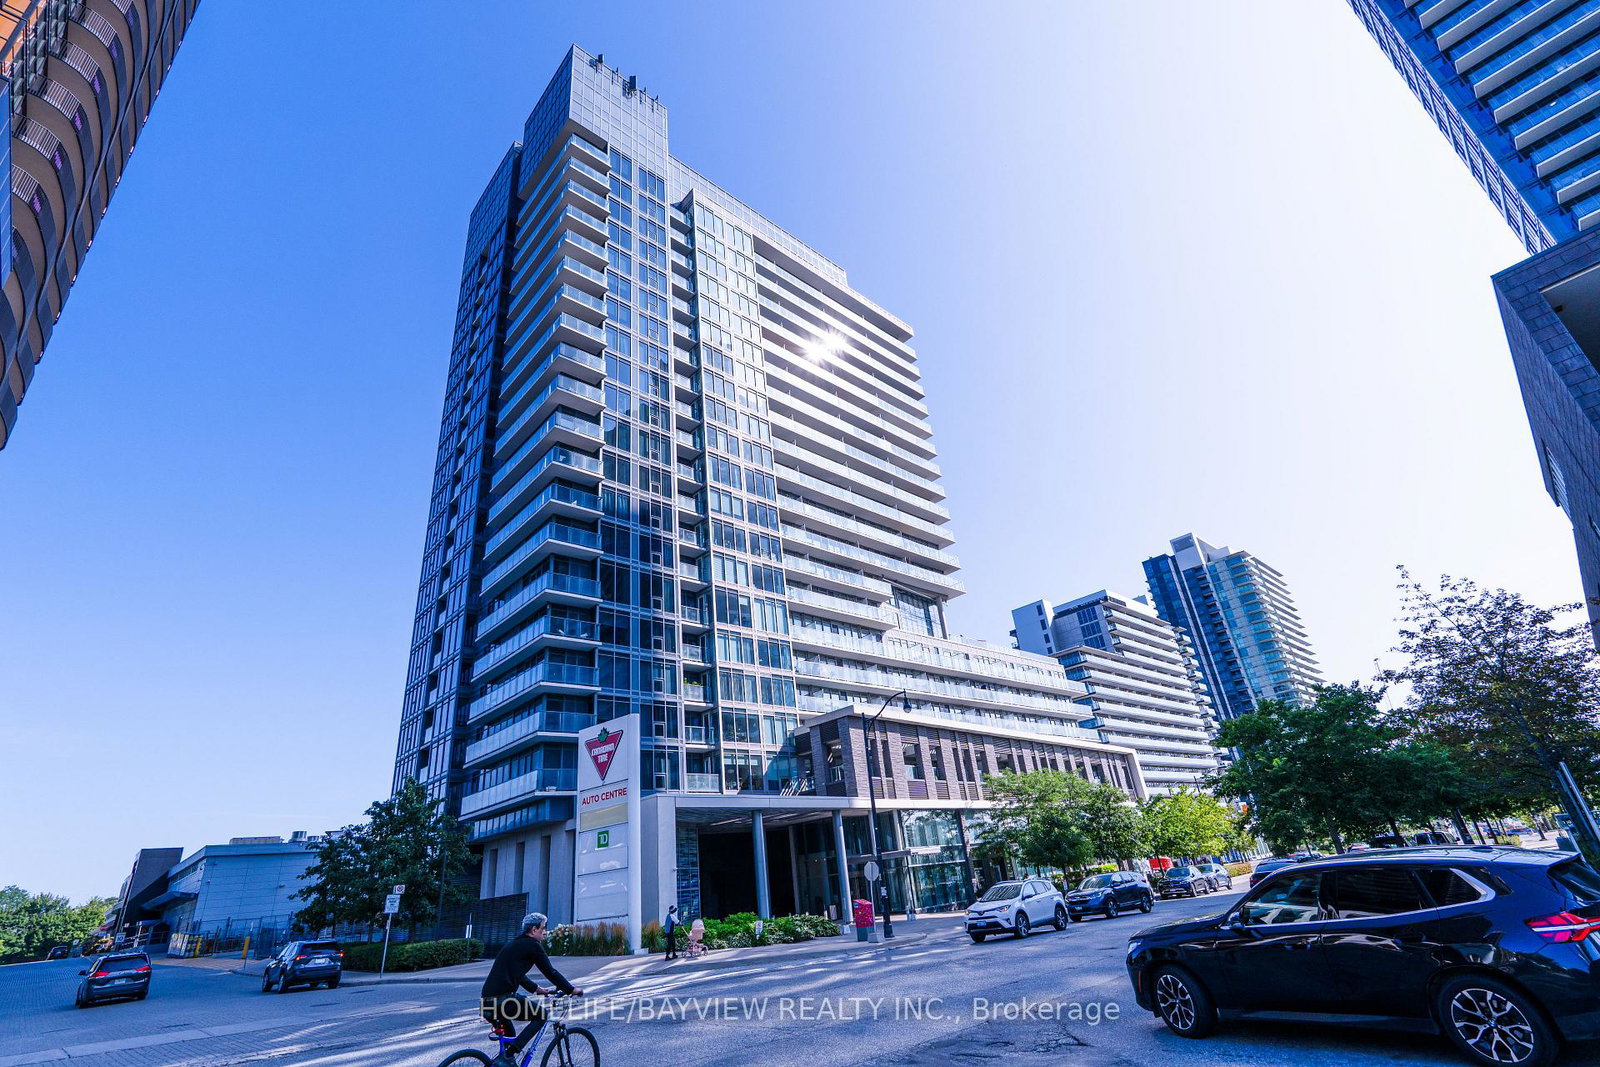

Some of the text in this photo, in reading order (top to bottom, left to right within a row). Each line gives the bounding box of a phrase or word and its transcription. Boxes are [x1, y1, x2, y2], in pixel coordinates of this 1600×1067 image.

[582, 788, 627, 806] AUTO CENTRE
[598, 834, 608, 844] TD
